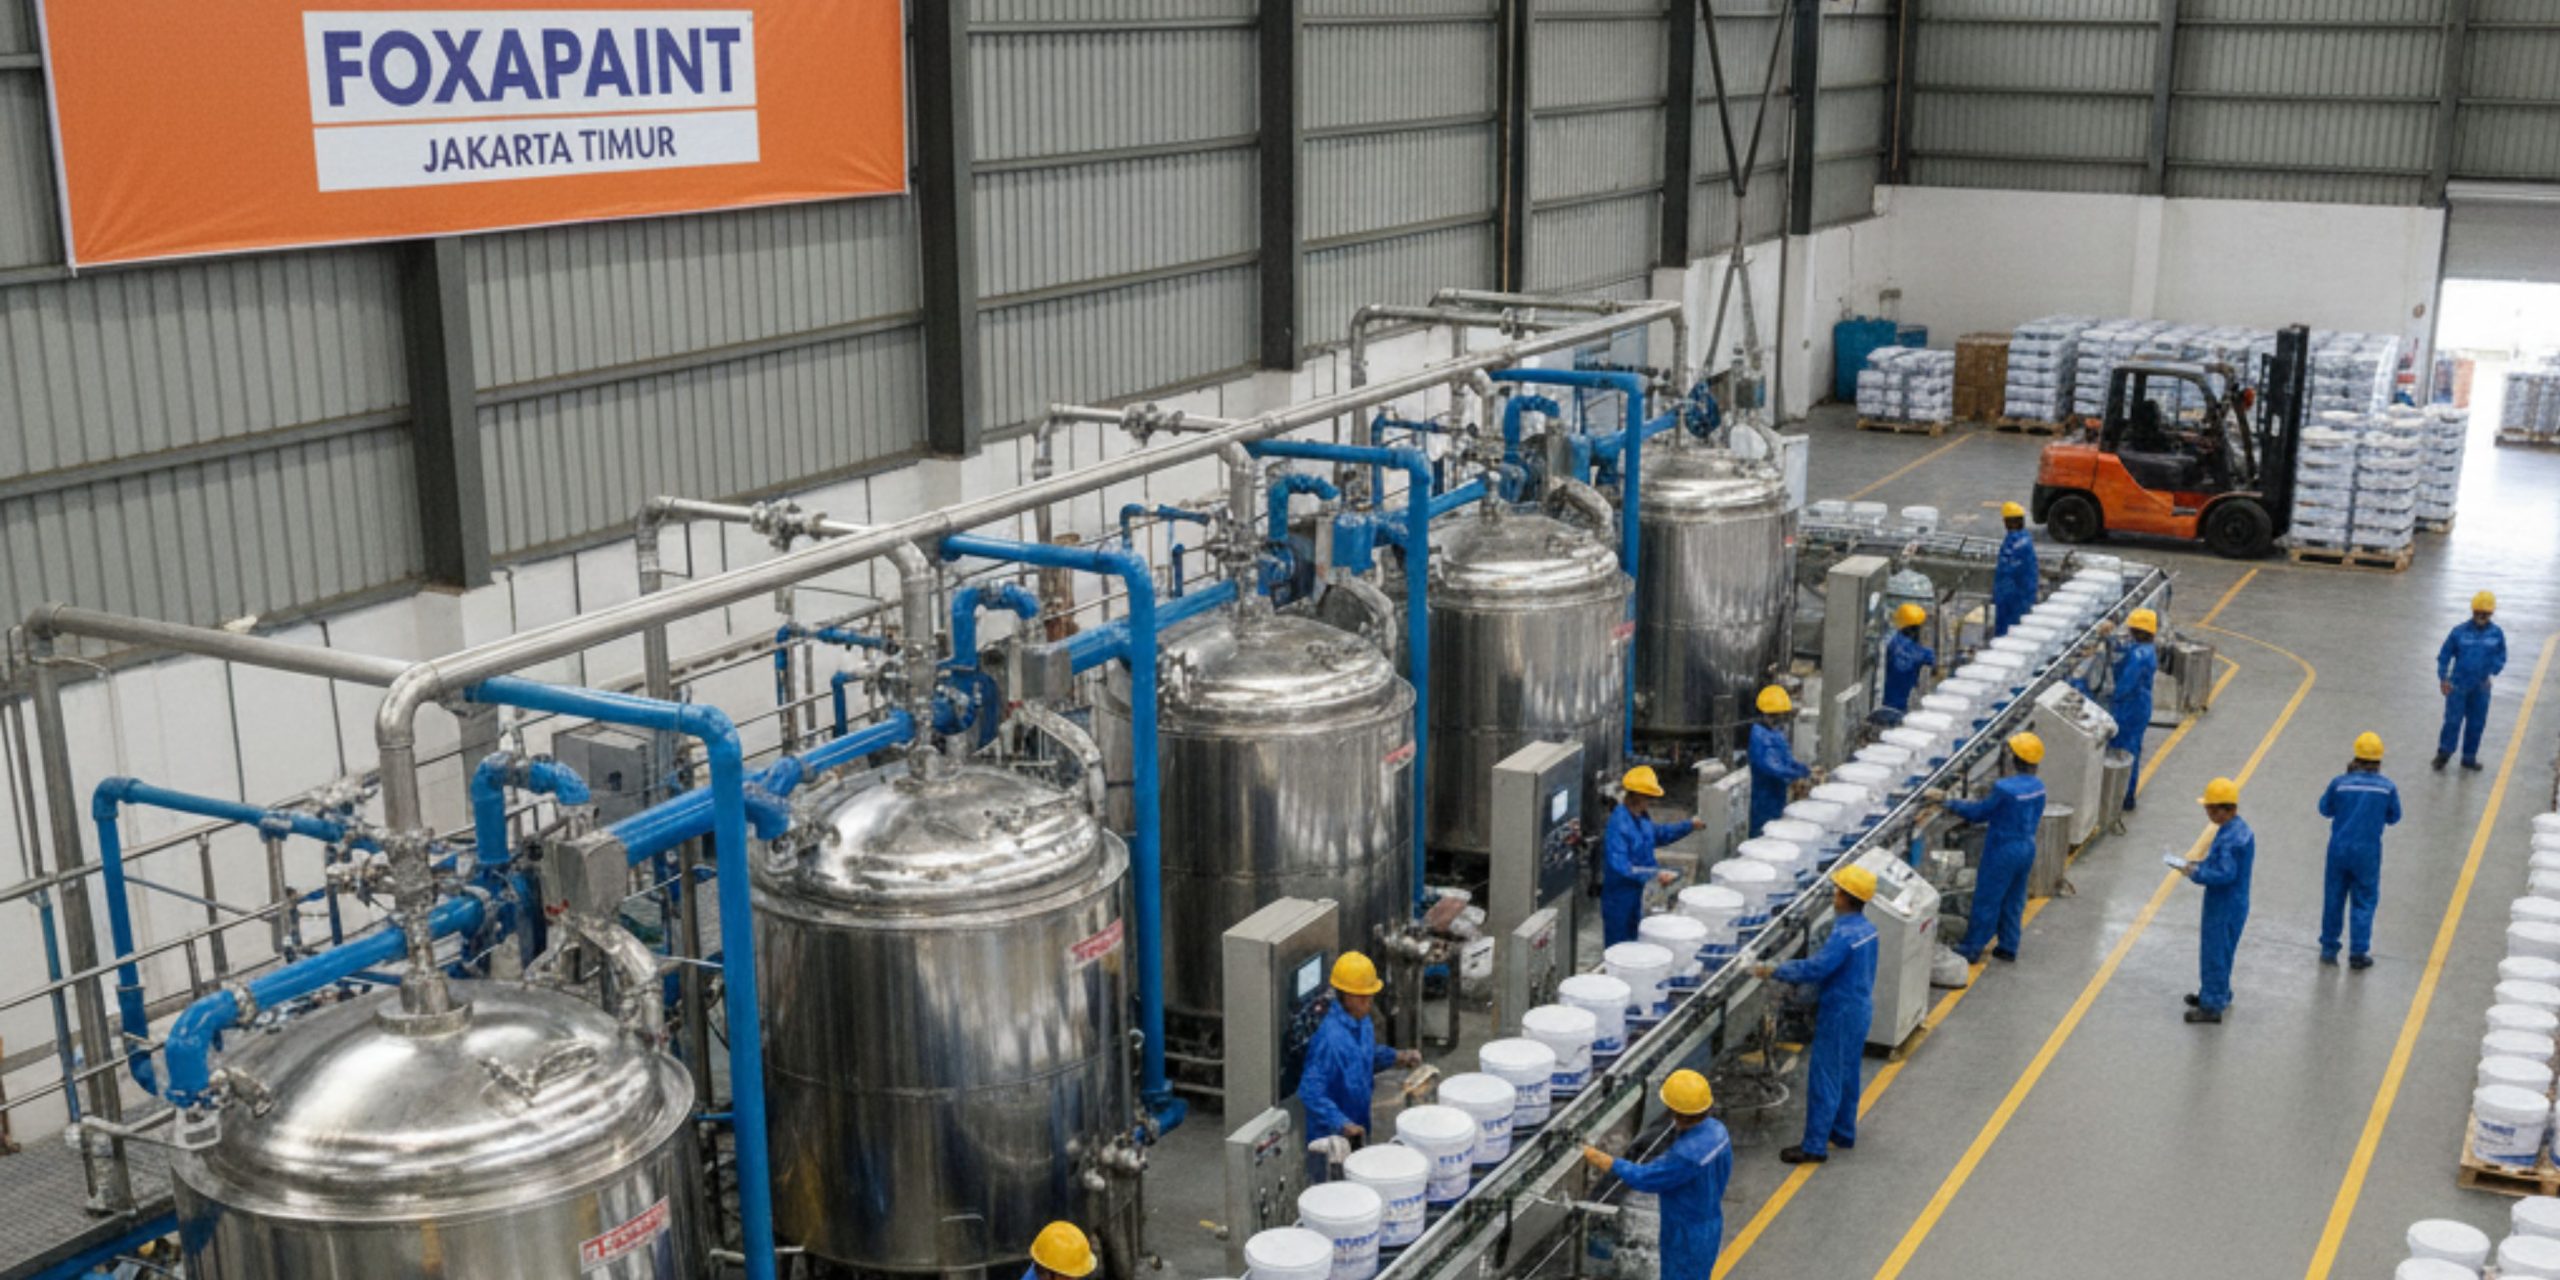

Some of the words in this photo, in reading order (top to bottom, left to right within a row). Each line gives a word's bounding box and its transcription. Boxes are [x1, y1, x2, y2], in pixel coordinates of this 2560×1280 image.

[324, 27, 742, 107] FOXAPAINT
[423, 132, 573, 173] JAKARTA
[579, 126, 677, 162] TIMUR
